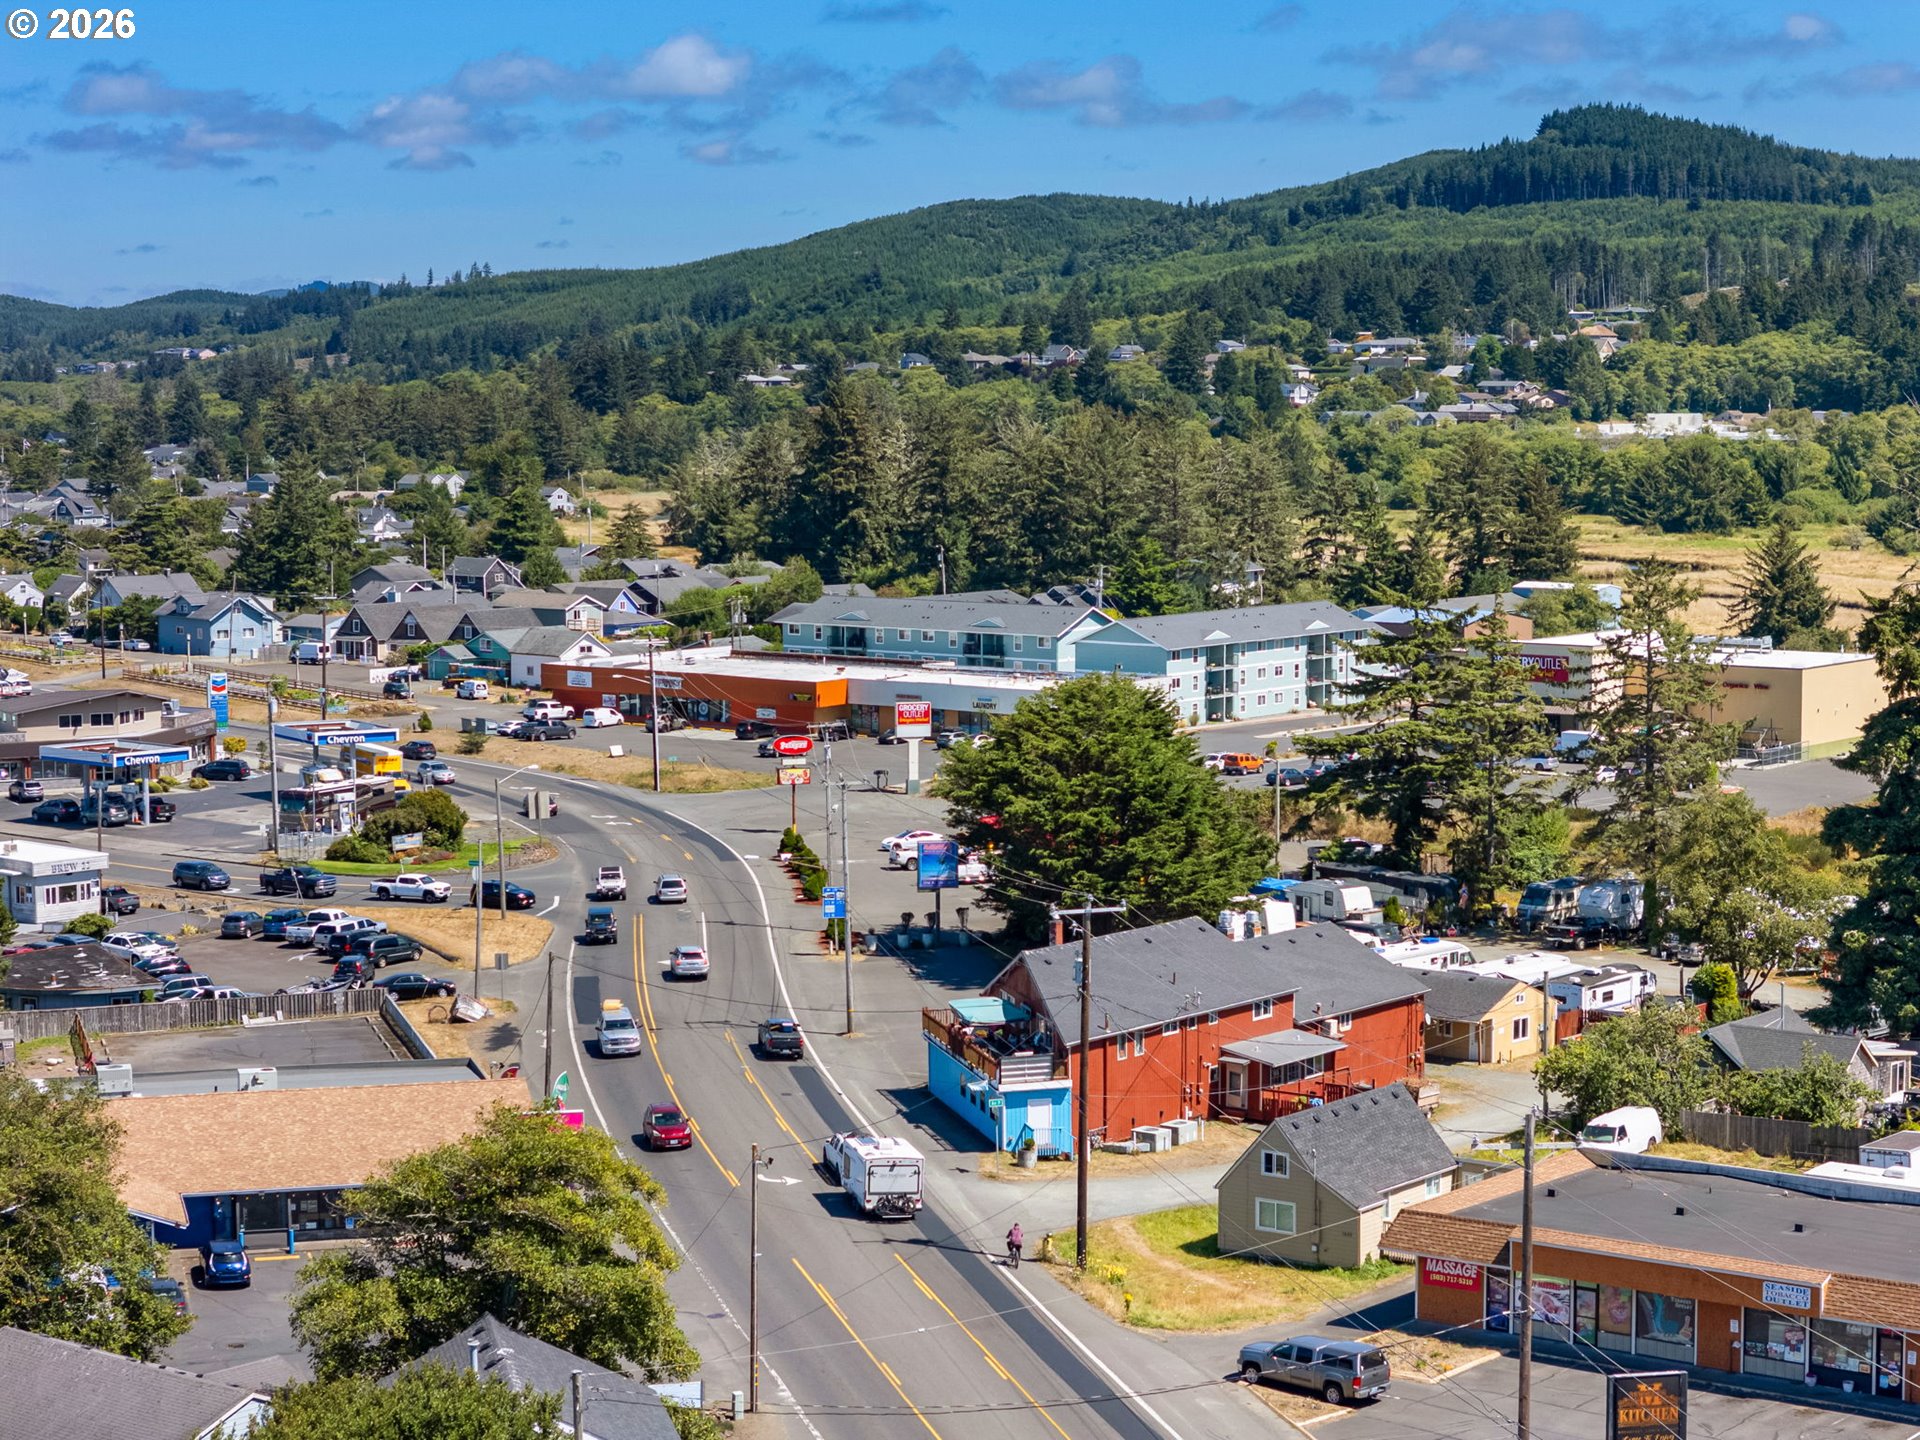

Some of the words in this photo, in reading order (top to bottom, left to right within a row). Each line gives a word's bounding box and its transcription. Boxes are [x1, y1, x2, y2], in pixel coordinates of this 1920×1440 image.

[327, 735, 366, 744] Chevron
[124, 755, 161, 766] Chevron
[51, 862, 78, 873] BREW
[1426, 1258, 1478, 1278] MASSAGE
[1765, 1283, 1809, 1296] SEASIDE
[1765, 1290, 1809, 1301] TOBACCO
[1765, 1295, 1809, 1308] OUTLET
[1619, 1407, 1679, 1423] KITCHEN
